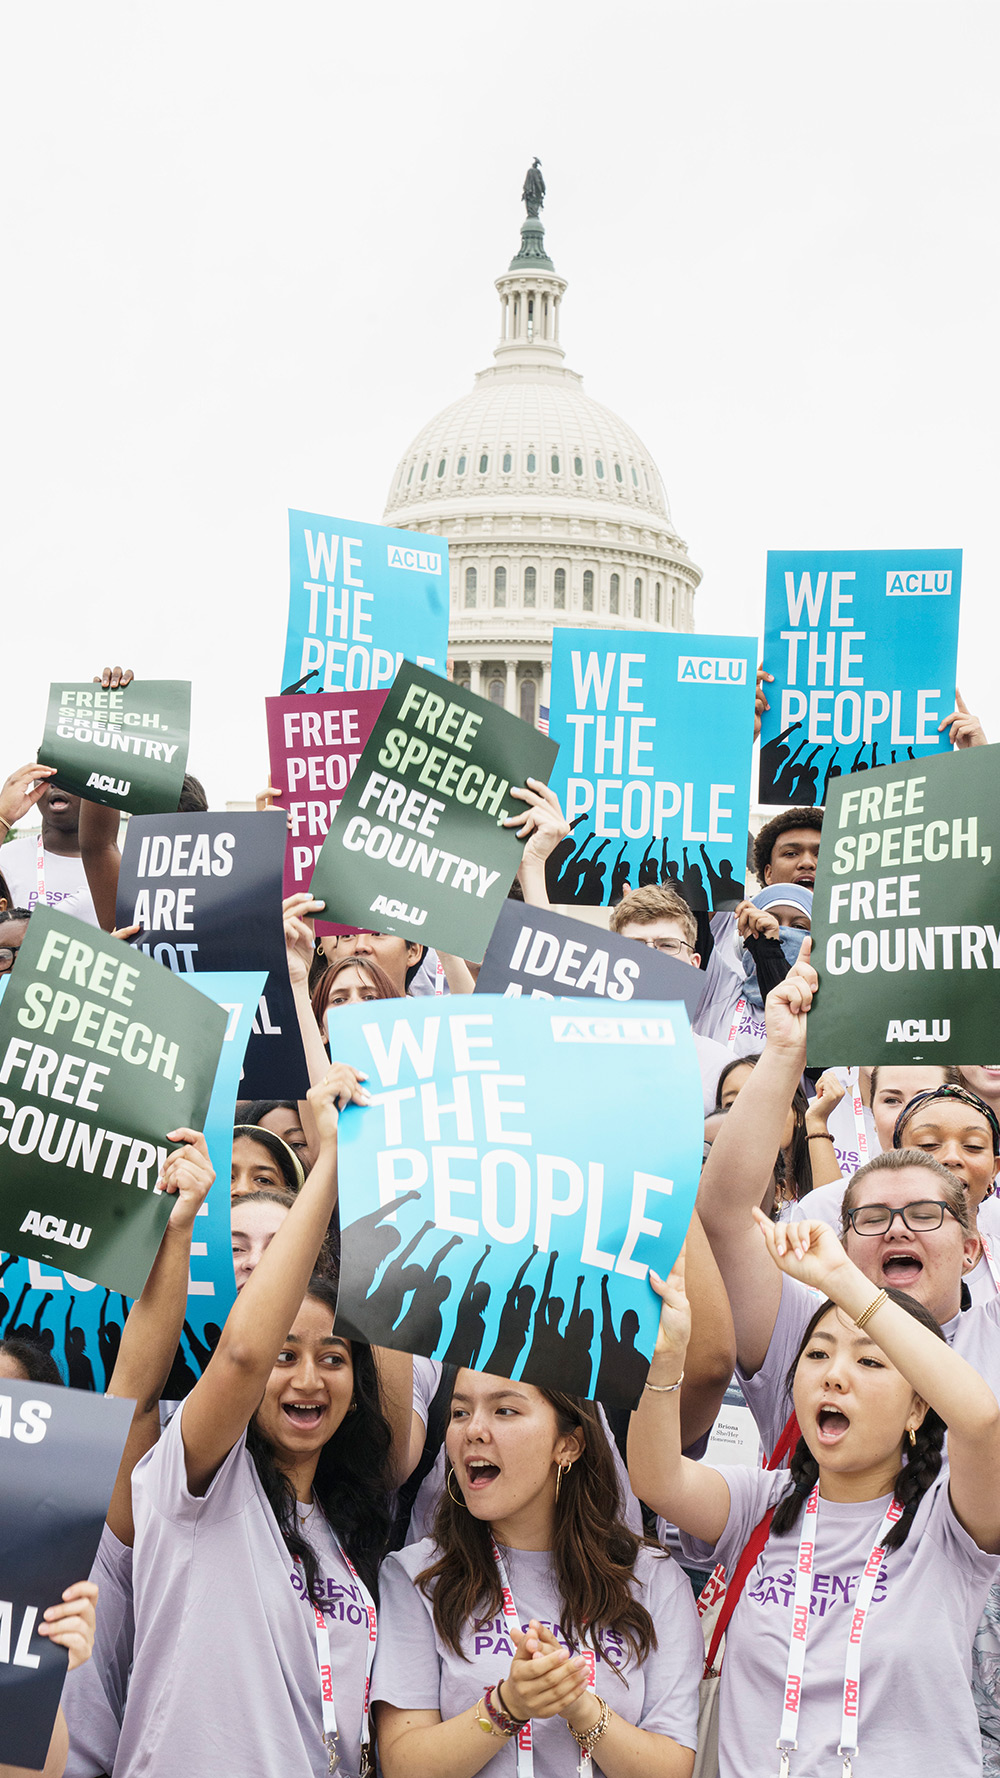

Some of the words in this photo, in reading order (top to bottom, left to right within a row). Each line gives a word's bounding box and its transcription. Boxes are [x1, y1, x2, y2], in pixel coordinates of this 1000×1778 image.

[304, 529, 363, 588] WE
[391, 549, 438, 571] ACLU
[784, 571, 856, 626] WE
[889, 573, 948, 593] ACLU
[303, 581, 374, 643] THE
[299, 636, 435, 692] PEOP
[681, 659, 743, 682] ACLU
[780, 631, 866, 686] THE
[60, 690, 124, 709] FREE
[571, 650, 646, 712] WE
[58, 707, 169, 731] SPEECH,
[58, 717, 122, 733] FREE
[283, 709, 361, 748] FREE
[397, 683, 483, 753] FREE
[780, 689, 941, 744] PEOPLE
[56, 724, 179, 763] COUNTRY
[566, 714, 656, 776] THE
[86, 772, 131, 796] ACLU
[378, 728, 510, 827] SPEECH,
[358, 770, 446, 838] FREE
[565, 777, 736, 843] PEOPLE
[838, 775, 926, 829] FREE
[137, 832, 236, 878] IDEAS
[342, 815, 501, 899] COUNTRY
[831, 816, 992, 875] SPEECH,
[132, 888, 196, 931] ARE
[369, 894, 428, 926] ACLU
[828, 874, 921, 924] FREE
[36, 929, 141, 1007] FREE
[509, 925, 641, 1002] IDEAS
[17, 982, 186, 1092] SPEECH,
[362, 1013, 500, 1087] WE
[561, 1021, 666, 1039] ACLU
[885, 1018, 950, 1043] ACLU
[0, 1036, 111, 1112] FREE
[371, 1073, 532, 1146] THE
[19, 1210, 92, 1250] ACLU
[376, 1145, 675, 1281] PEOPLE
[717, 1423, 739, 1431] Briona
[799, 1542, 813, 1574] ACLU
[864, 1546, 886, 1578] ACLU
[366, 1605, 377, 1642] ACLU
[793, 1605, 808, 1641] ACLU
[849, 1608, 866, 1644] ACLU
[321, 1664, 334, 1702] ACLU
[785, 1675, 801, 1713] ACLU
[844, 1678, 858, 1717] ACLU
[519, 1719, 532, 1751] CLU
